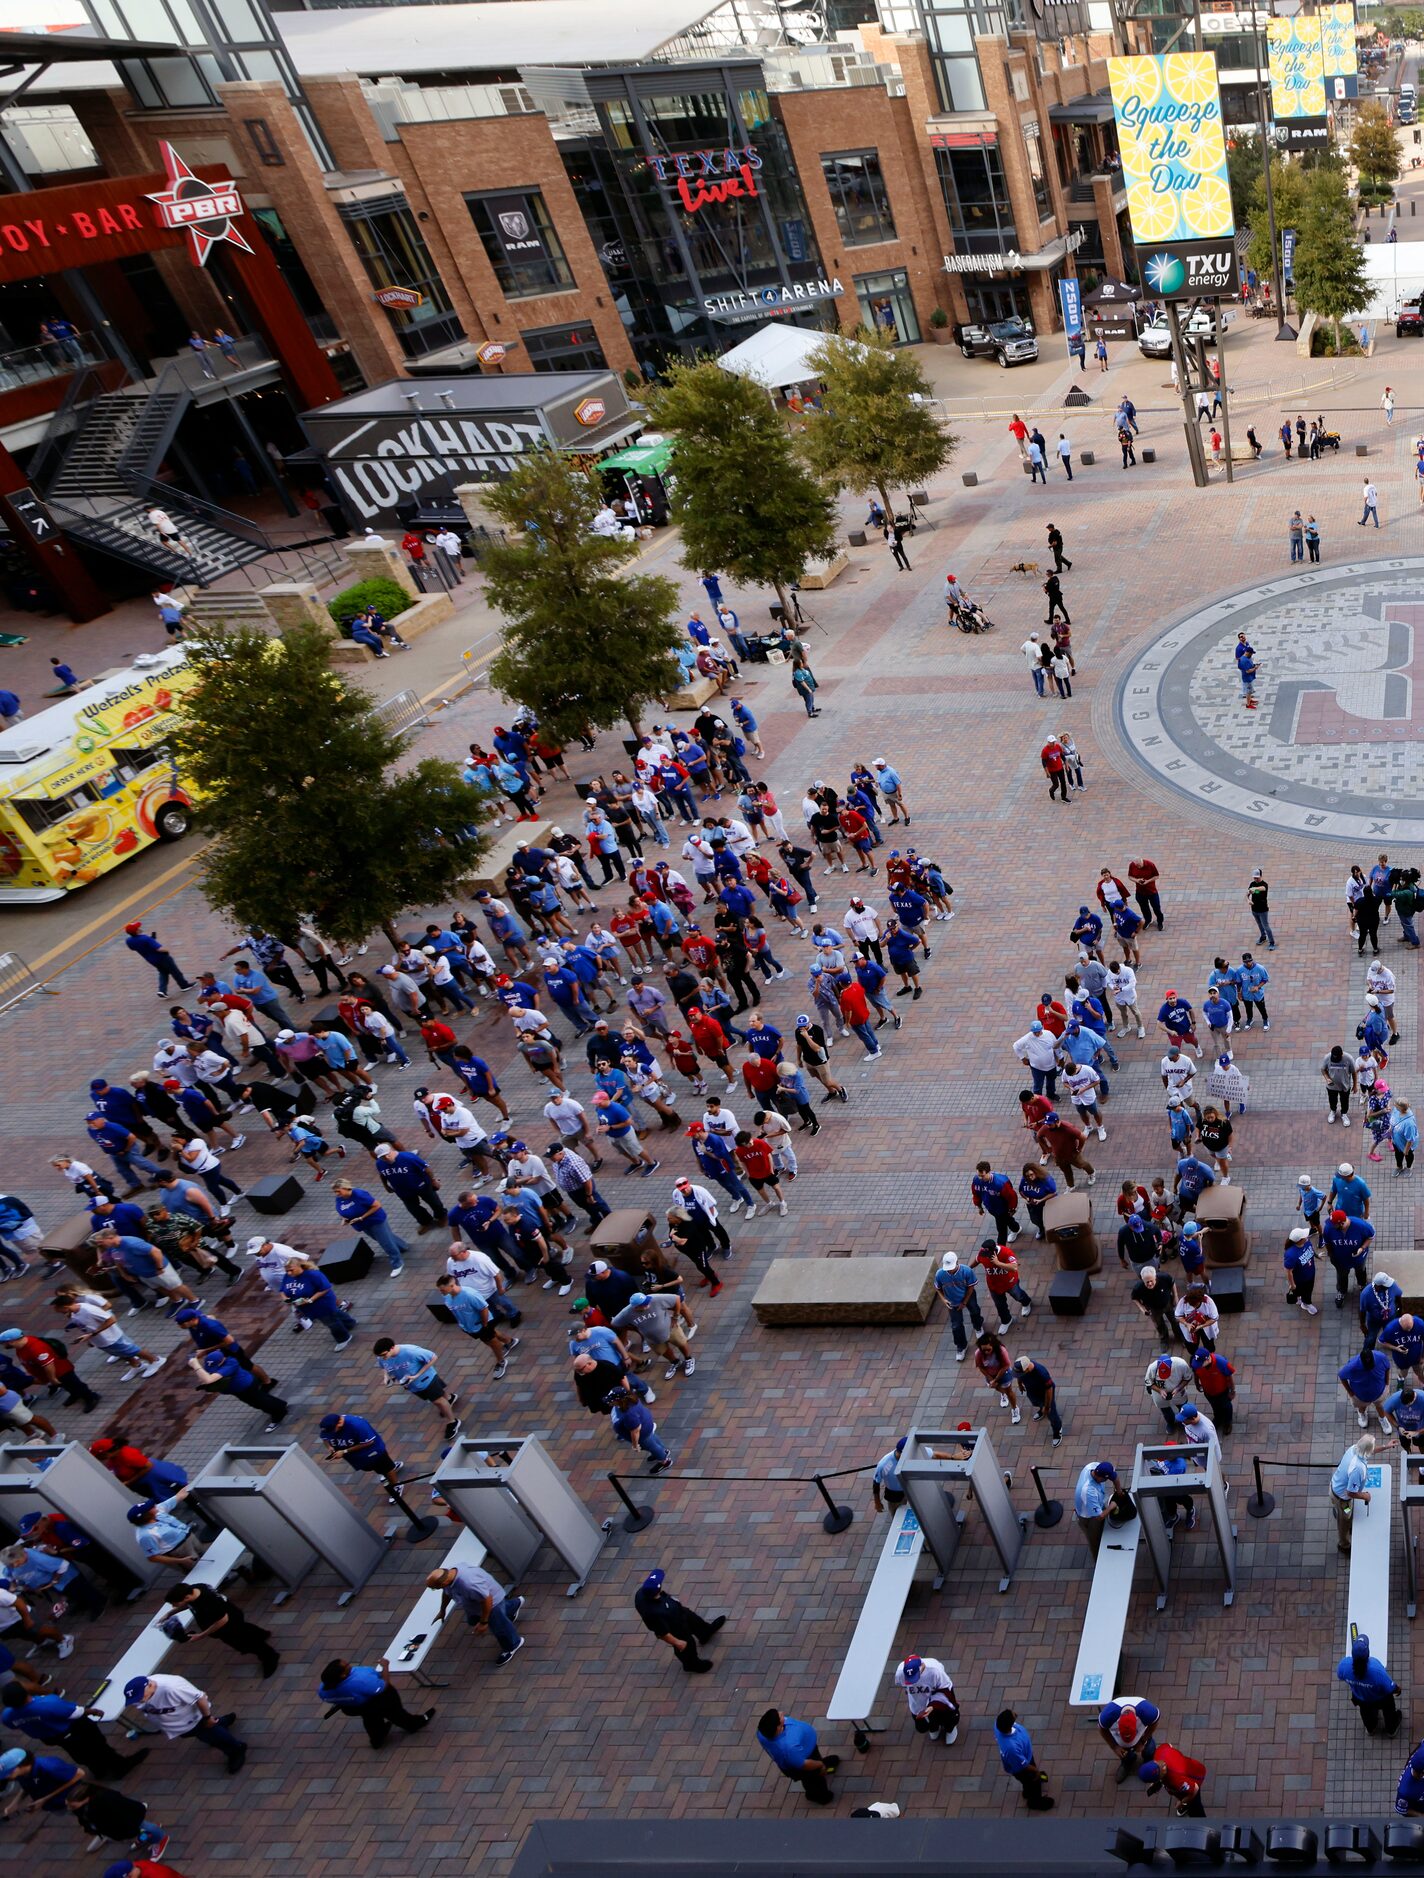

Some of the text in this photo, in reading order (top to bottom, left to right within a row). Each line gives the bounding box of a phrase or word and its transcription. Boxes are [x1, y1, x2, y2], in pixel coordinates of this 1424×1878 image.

[1271, 39, 1321, 61] Squeeze
[1285, 57, 1305, 72] the
[1121, 96, 1219, 140] Squeeze
[1291, 129, 1328, 138] RAM
[1149, 129, 1191, 160] the
[647, 146, 763, 180] TEXAS
[677, 164, 760, 212] Live!
[169, 195, 239, 222] PBR
[0, 204, 143, 256] OY BAR
[505, 240, 541, 251] RAM
[1284, 233, 1293, 265] 1500
[944, 254, 1004, 278] BASEBALLISM
[1186, 252, 1232, 274] TXU
[1188, 271, 1230, 287] energy
[781, 278, 844, 301] ARENA
[380, 292, 416, 305] LOCKHART
[1065, 282, 1079, 326] 2500
[335, 419, 547, 519] LOCKHART
[82, 659, 195, 719] Wetzel's Pretzel
[893, 901, 912, 909] TEXAS
[96, 1101, 107, 1111] T
[381, 1167, 408, 1176] TEXAS
[1024, 1186, 1041, 1194] TEXAS
[986, 1268, 1009, 1276] EXAS
[285, 1281, 306, 1290] TEXAS
[634, 1313, 657, 1324] TEXAS
[1395, 1334, 1421, 1344] TEXAS
[331, 1439, 354, 1447] EXAS
[126, 1689, 133, 1697] T
[909, 1687, 930, 1695] EXA
